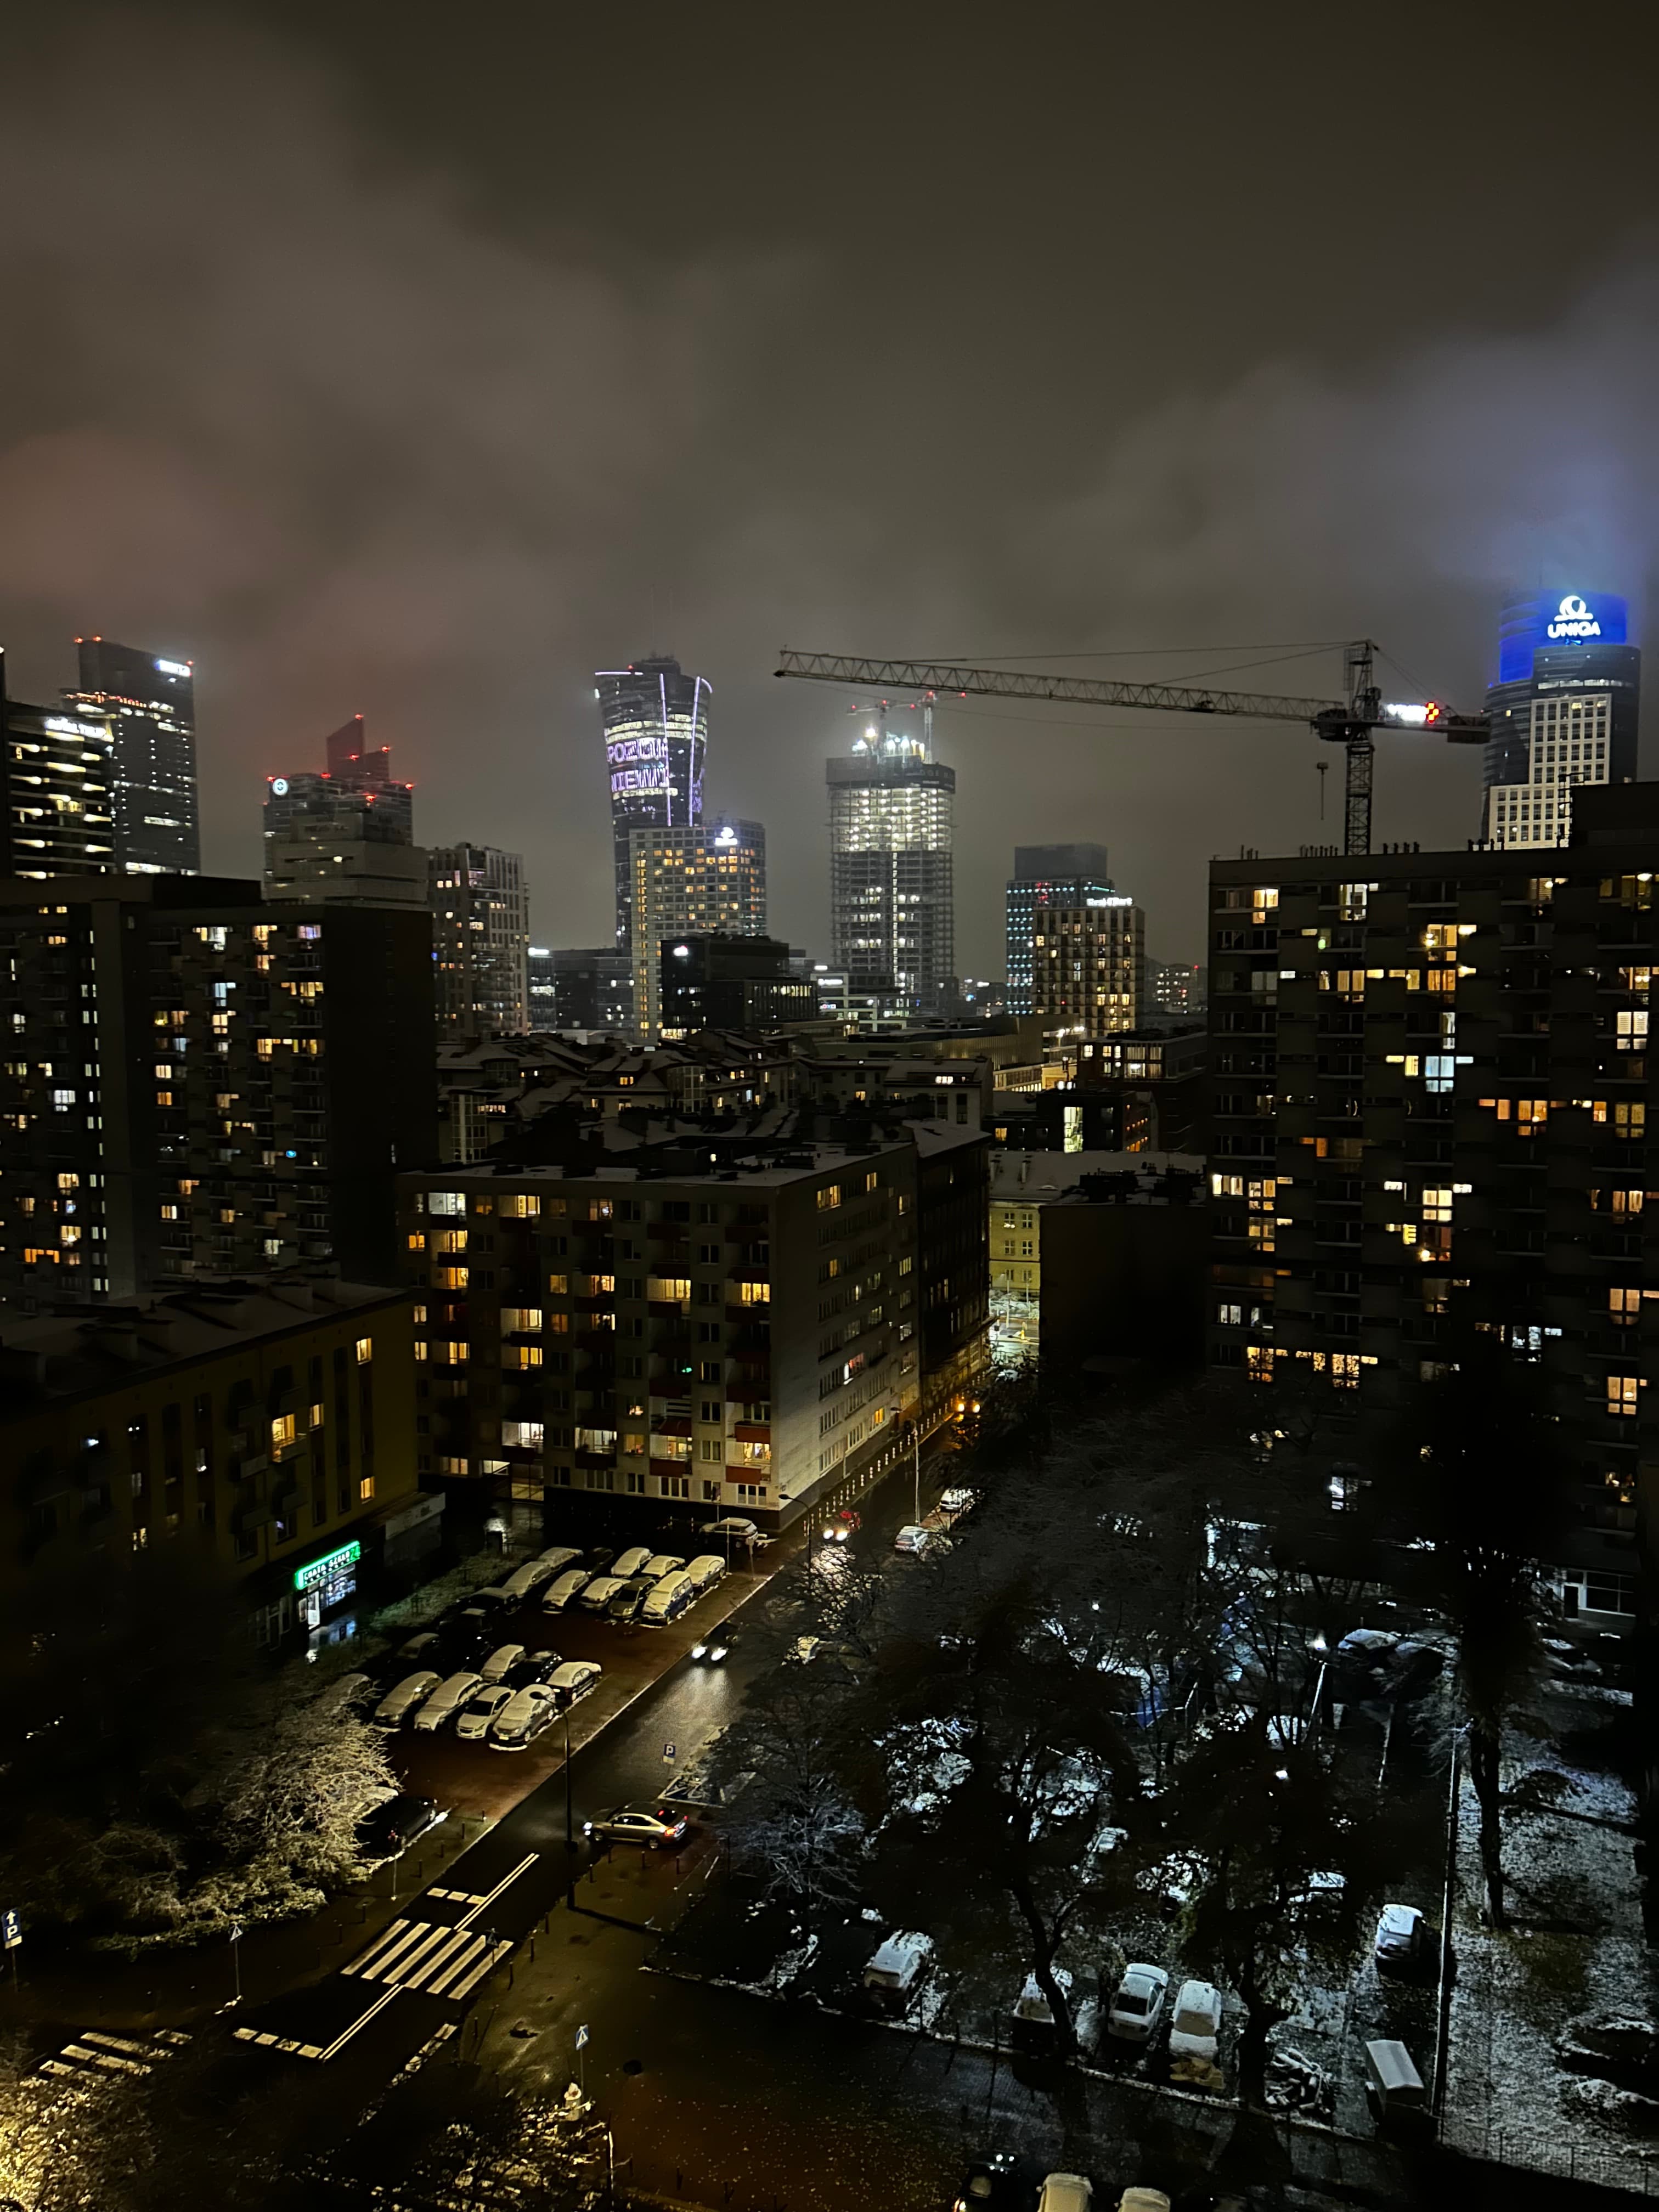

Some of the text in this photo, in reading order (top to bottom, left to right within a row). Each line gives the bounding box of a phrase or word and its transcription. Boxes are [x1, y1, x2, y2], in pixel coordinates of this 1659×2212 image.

[1547, 621, 1601, 639] UNIQA
[666, 1745, 674, 1755] P
[7, 1925, 18, 1939] P
